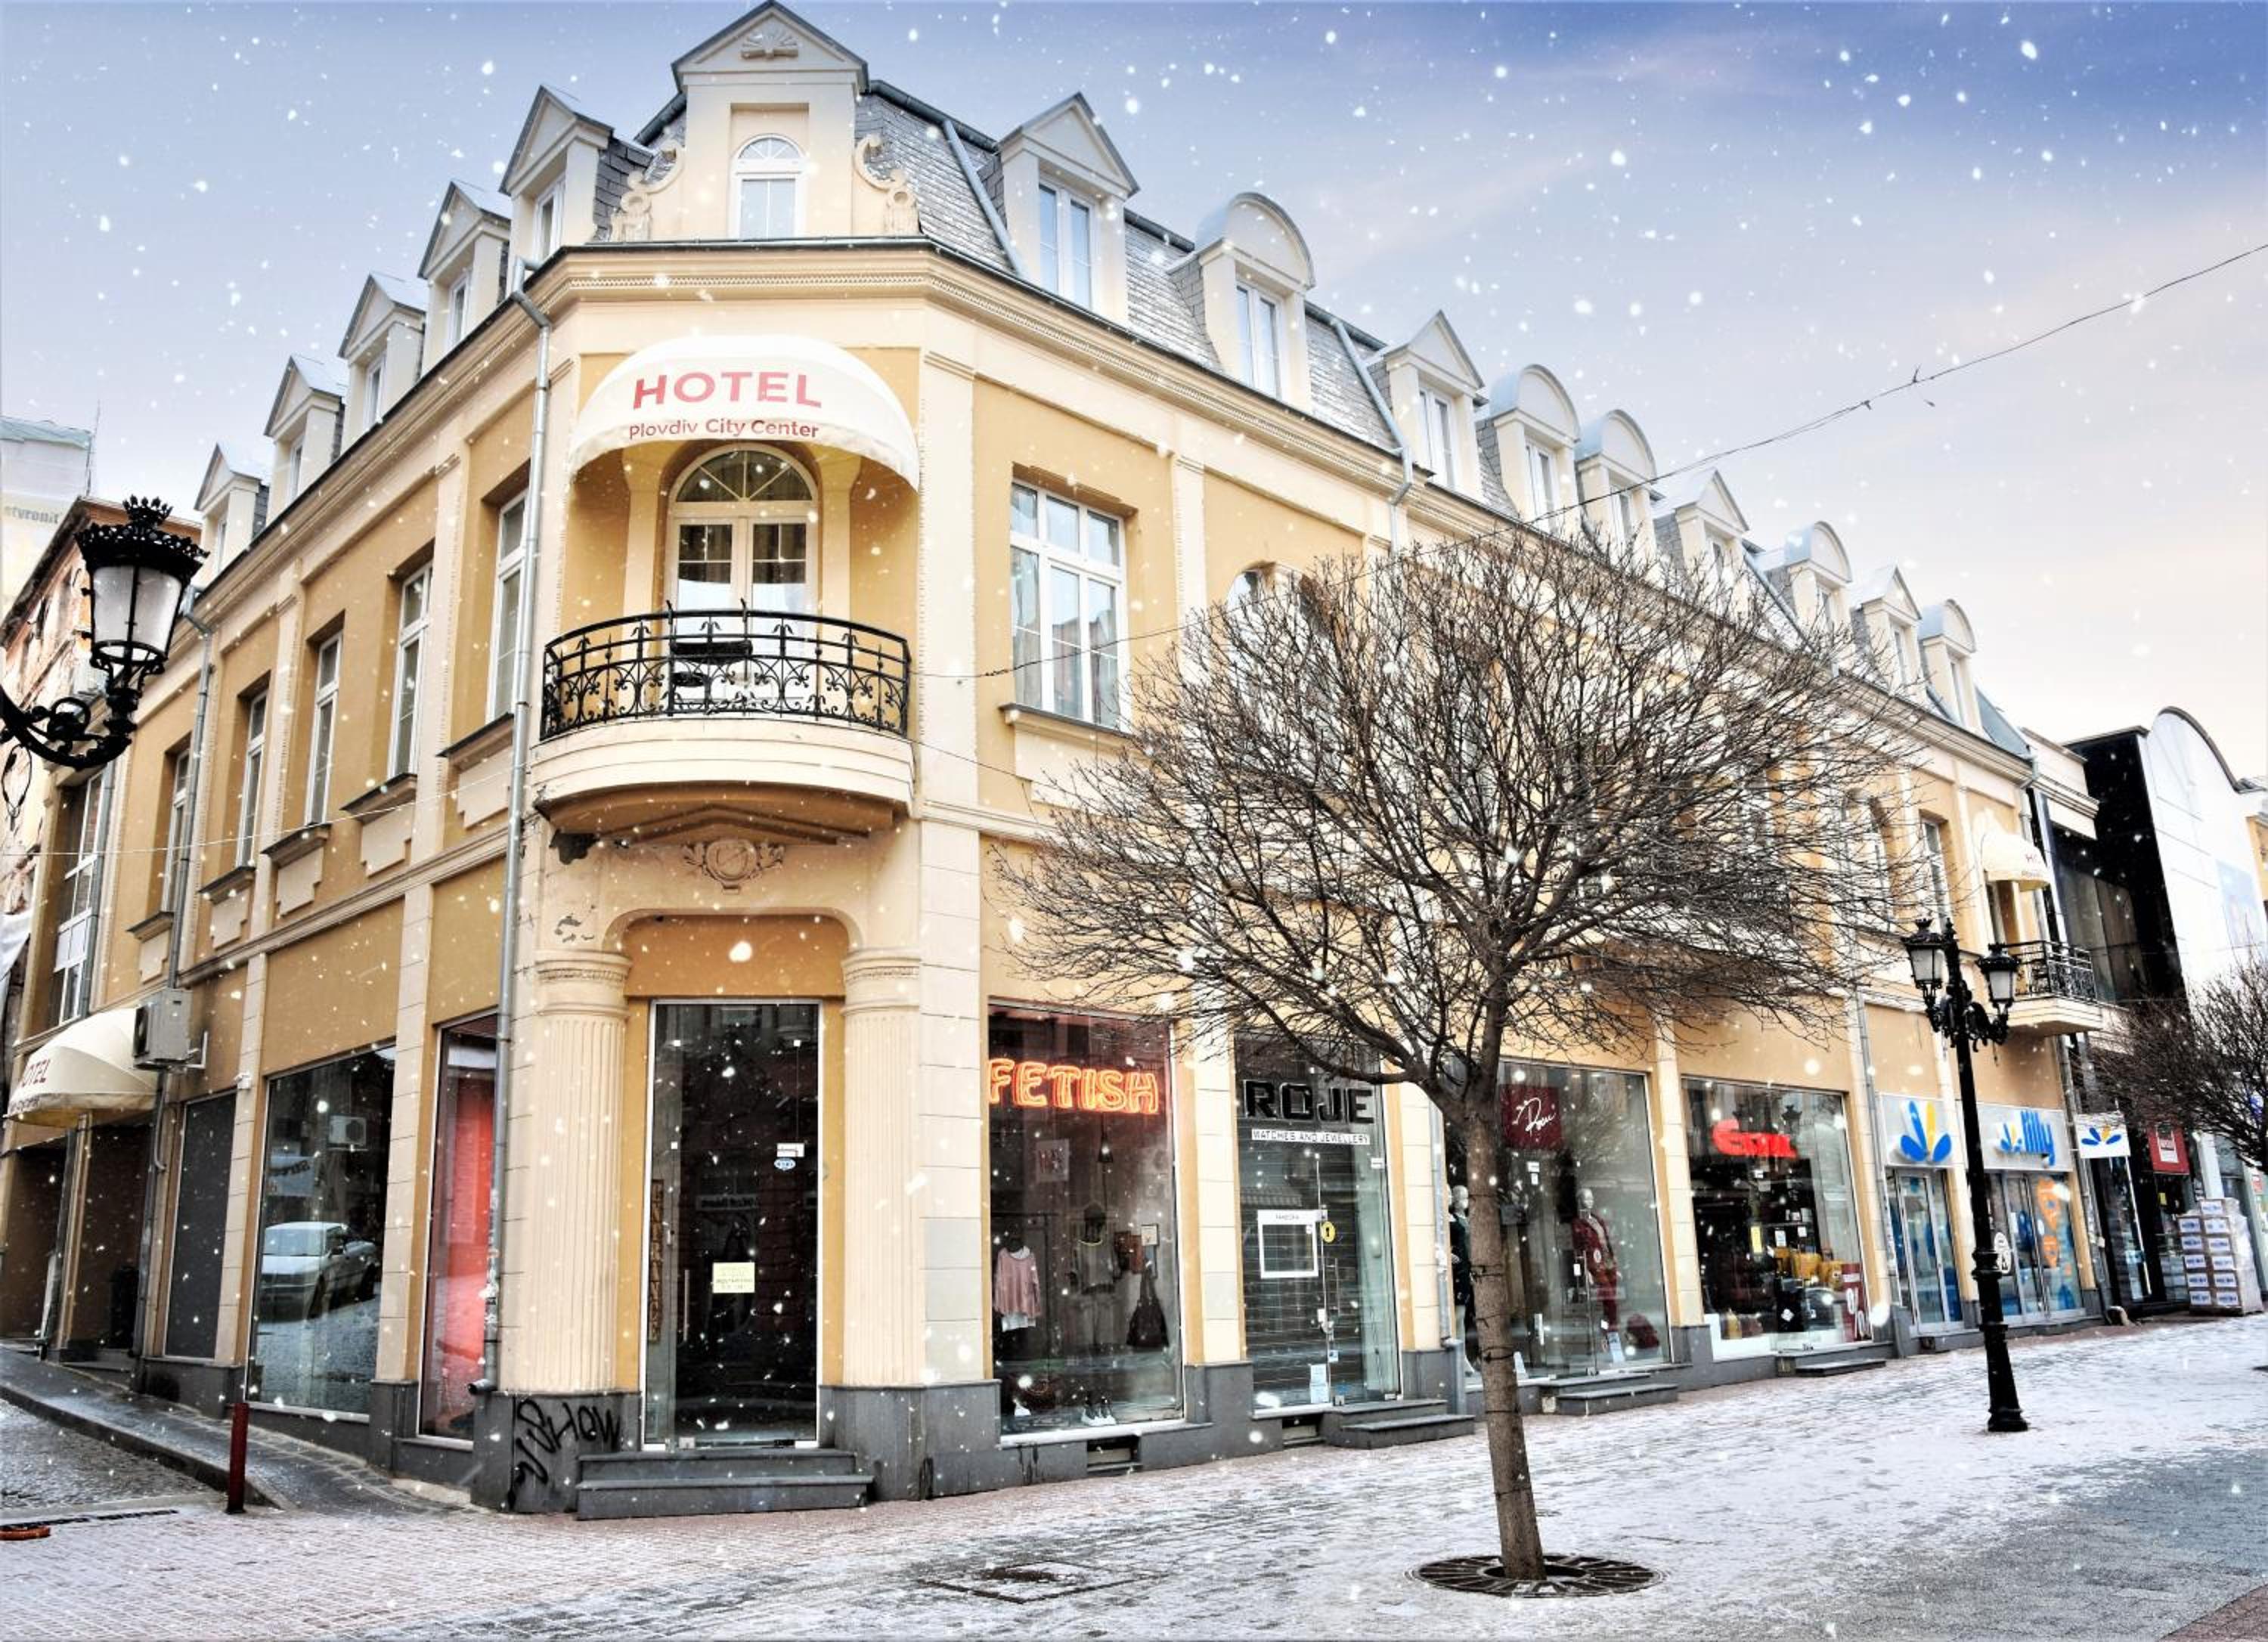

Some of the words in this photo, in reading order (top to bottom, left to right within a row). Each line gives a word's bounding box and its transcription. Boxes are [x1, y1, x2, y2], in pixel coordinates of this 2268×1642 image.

[633, 372, 822, 410] HOTEL
[630, 420, 698, 440] Plovdiv
[705, 418, 745, 437] City
[751, 420, 819, 438] Center
[987, 1058, 1160, 1114] FETISH
[1243, 1080, 1375, 1124] ROJE
[1253, 1129, 1296, 1141] WATCHES
[1300, 1132, 1317, 1142] AND
